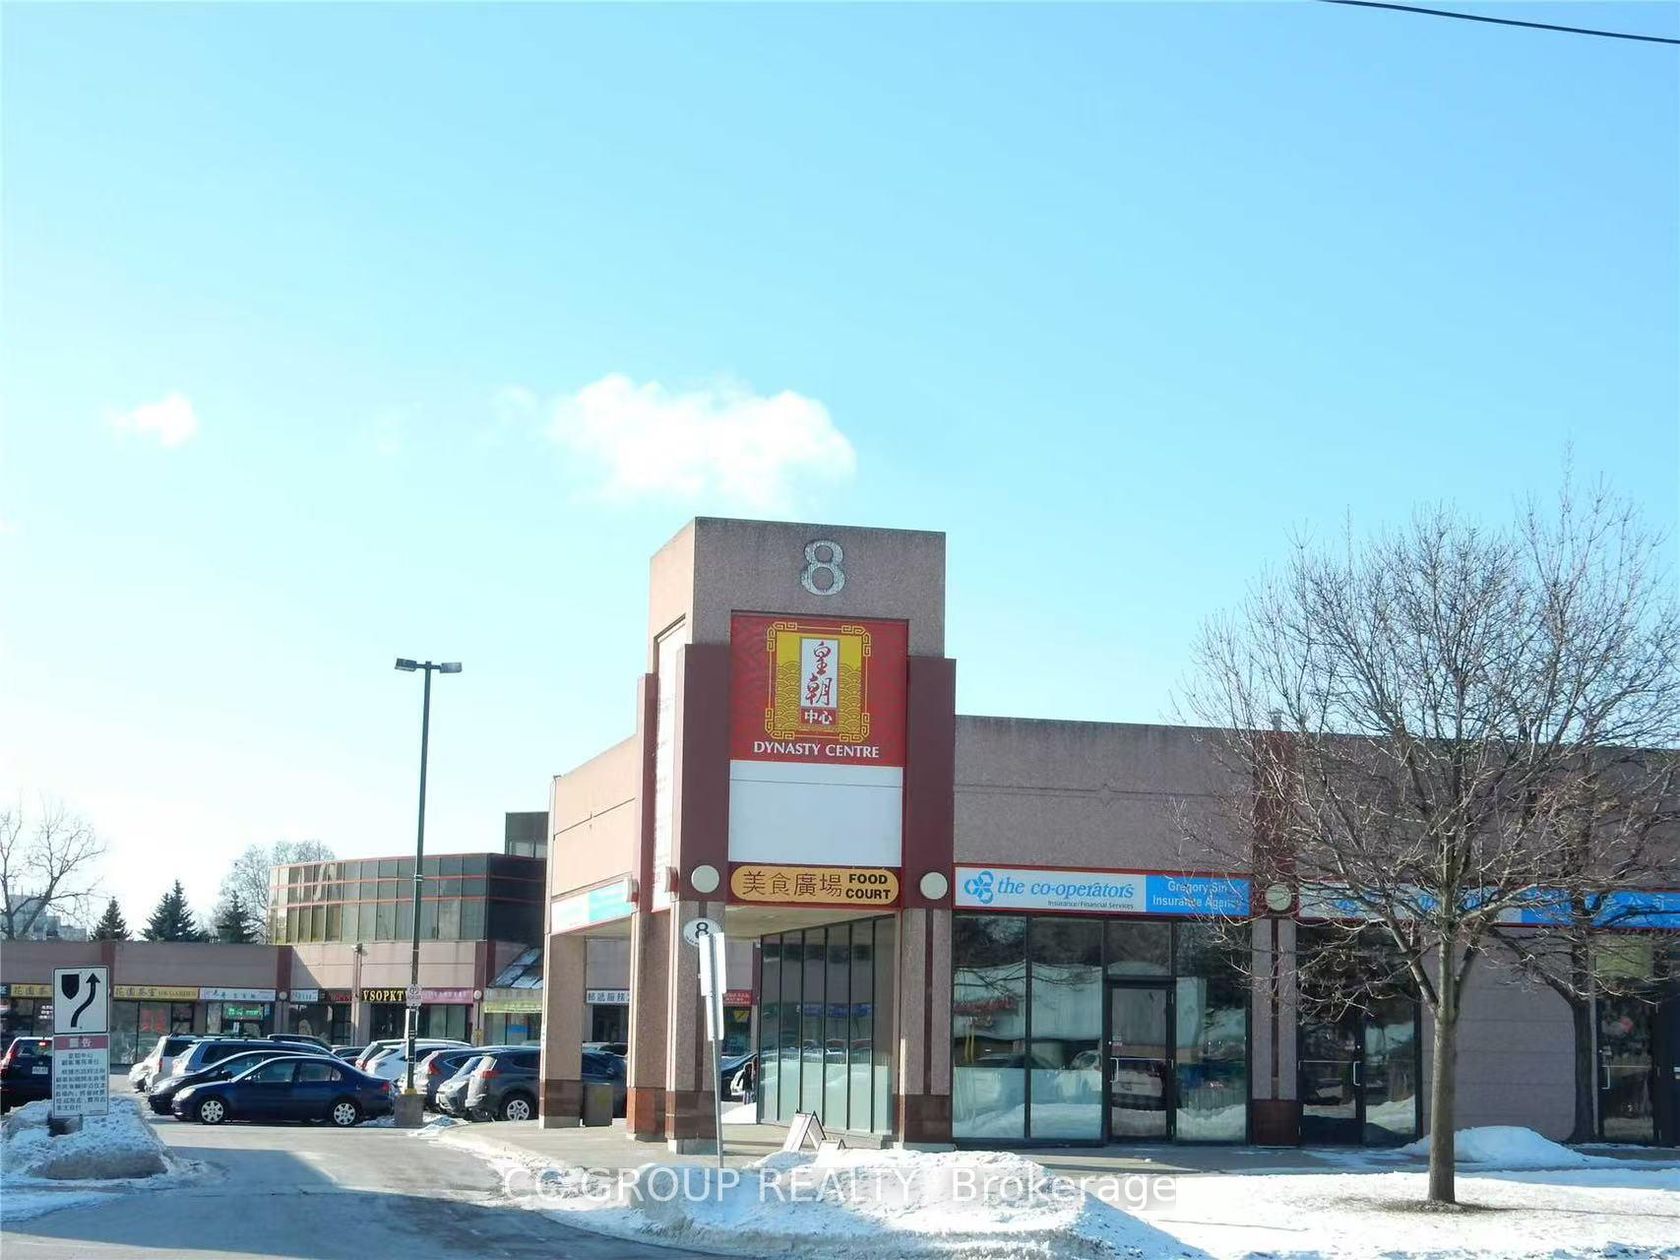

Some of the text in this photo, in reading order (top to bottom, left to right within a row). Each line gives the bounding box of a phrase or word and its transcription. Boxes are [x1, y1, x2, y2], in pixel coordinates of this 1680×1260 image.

[801, 540, 845, 596] 8
[804, 641, 834, 706] 皇朝
[804, 710, 833, 725] 中心
[754, 741, 880, 758] DYNASTY CENTRE
[742, 870, 842, 898] 美食廣場
[848, 874, 888, 885] FOOD
[997, 877, 1135, 900] the co-operators
[845, 888, 891, 900] COURT
[694, 921, 710, 940] 8
